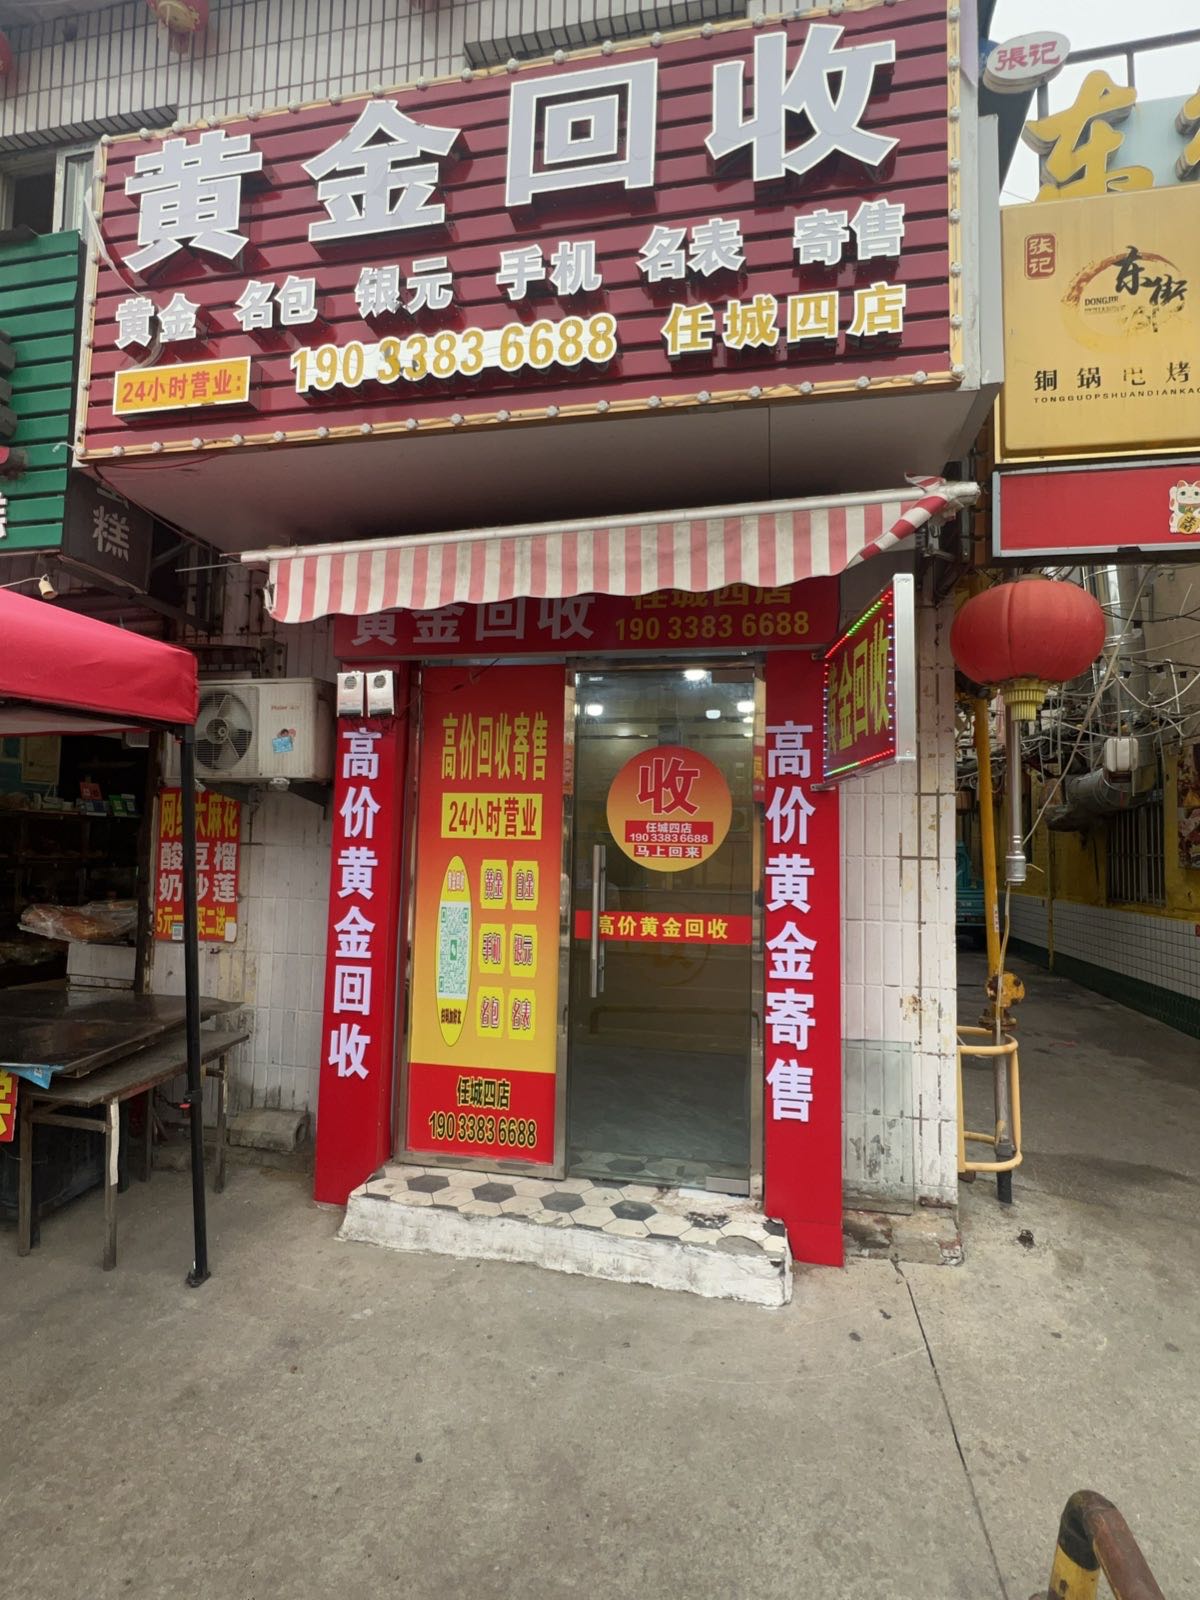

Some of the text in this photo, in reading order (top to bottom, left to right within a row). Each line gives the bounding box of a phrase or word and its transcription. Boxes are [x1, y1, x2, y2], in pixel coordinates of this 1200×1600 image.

[122, 23, 899, 273] 黄金回收
[1024, 70, 1200, 202] 东
[115, 199, 906, 348] 黄金 名包 银元 手机 名表 寄售
[289, 313, 618, 394] 190 3383 6688
[662, 282, 907, 355] 任城四店
[93, 487, 130, 562] 糕
[352, 595, 596, 647] 黄金回收
[615, 611, 810, 642] 190 3383 6688
[828, 617, 890, 756] 黄金回收
[441, 711, 548, 781] 高价回收寄售
[448, 797, 537, 838] 24小时营业
[636, 757, 700, 816] 收
[635, 846, 701, 858] 马上回来
[328, 727, 381, 1080] 高价黄金回收
[599, 915, 729, 939] 高价黄金回收
[765, 721, 816, 1123] 高价黄金寄售
[456, 1076, 511, 1110] 任城四店
[429, 1111, 537, 1148] 190 3383 6688
